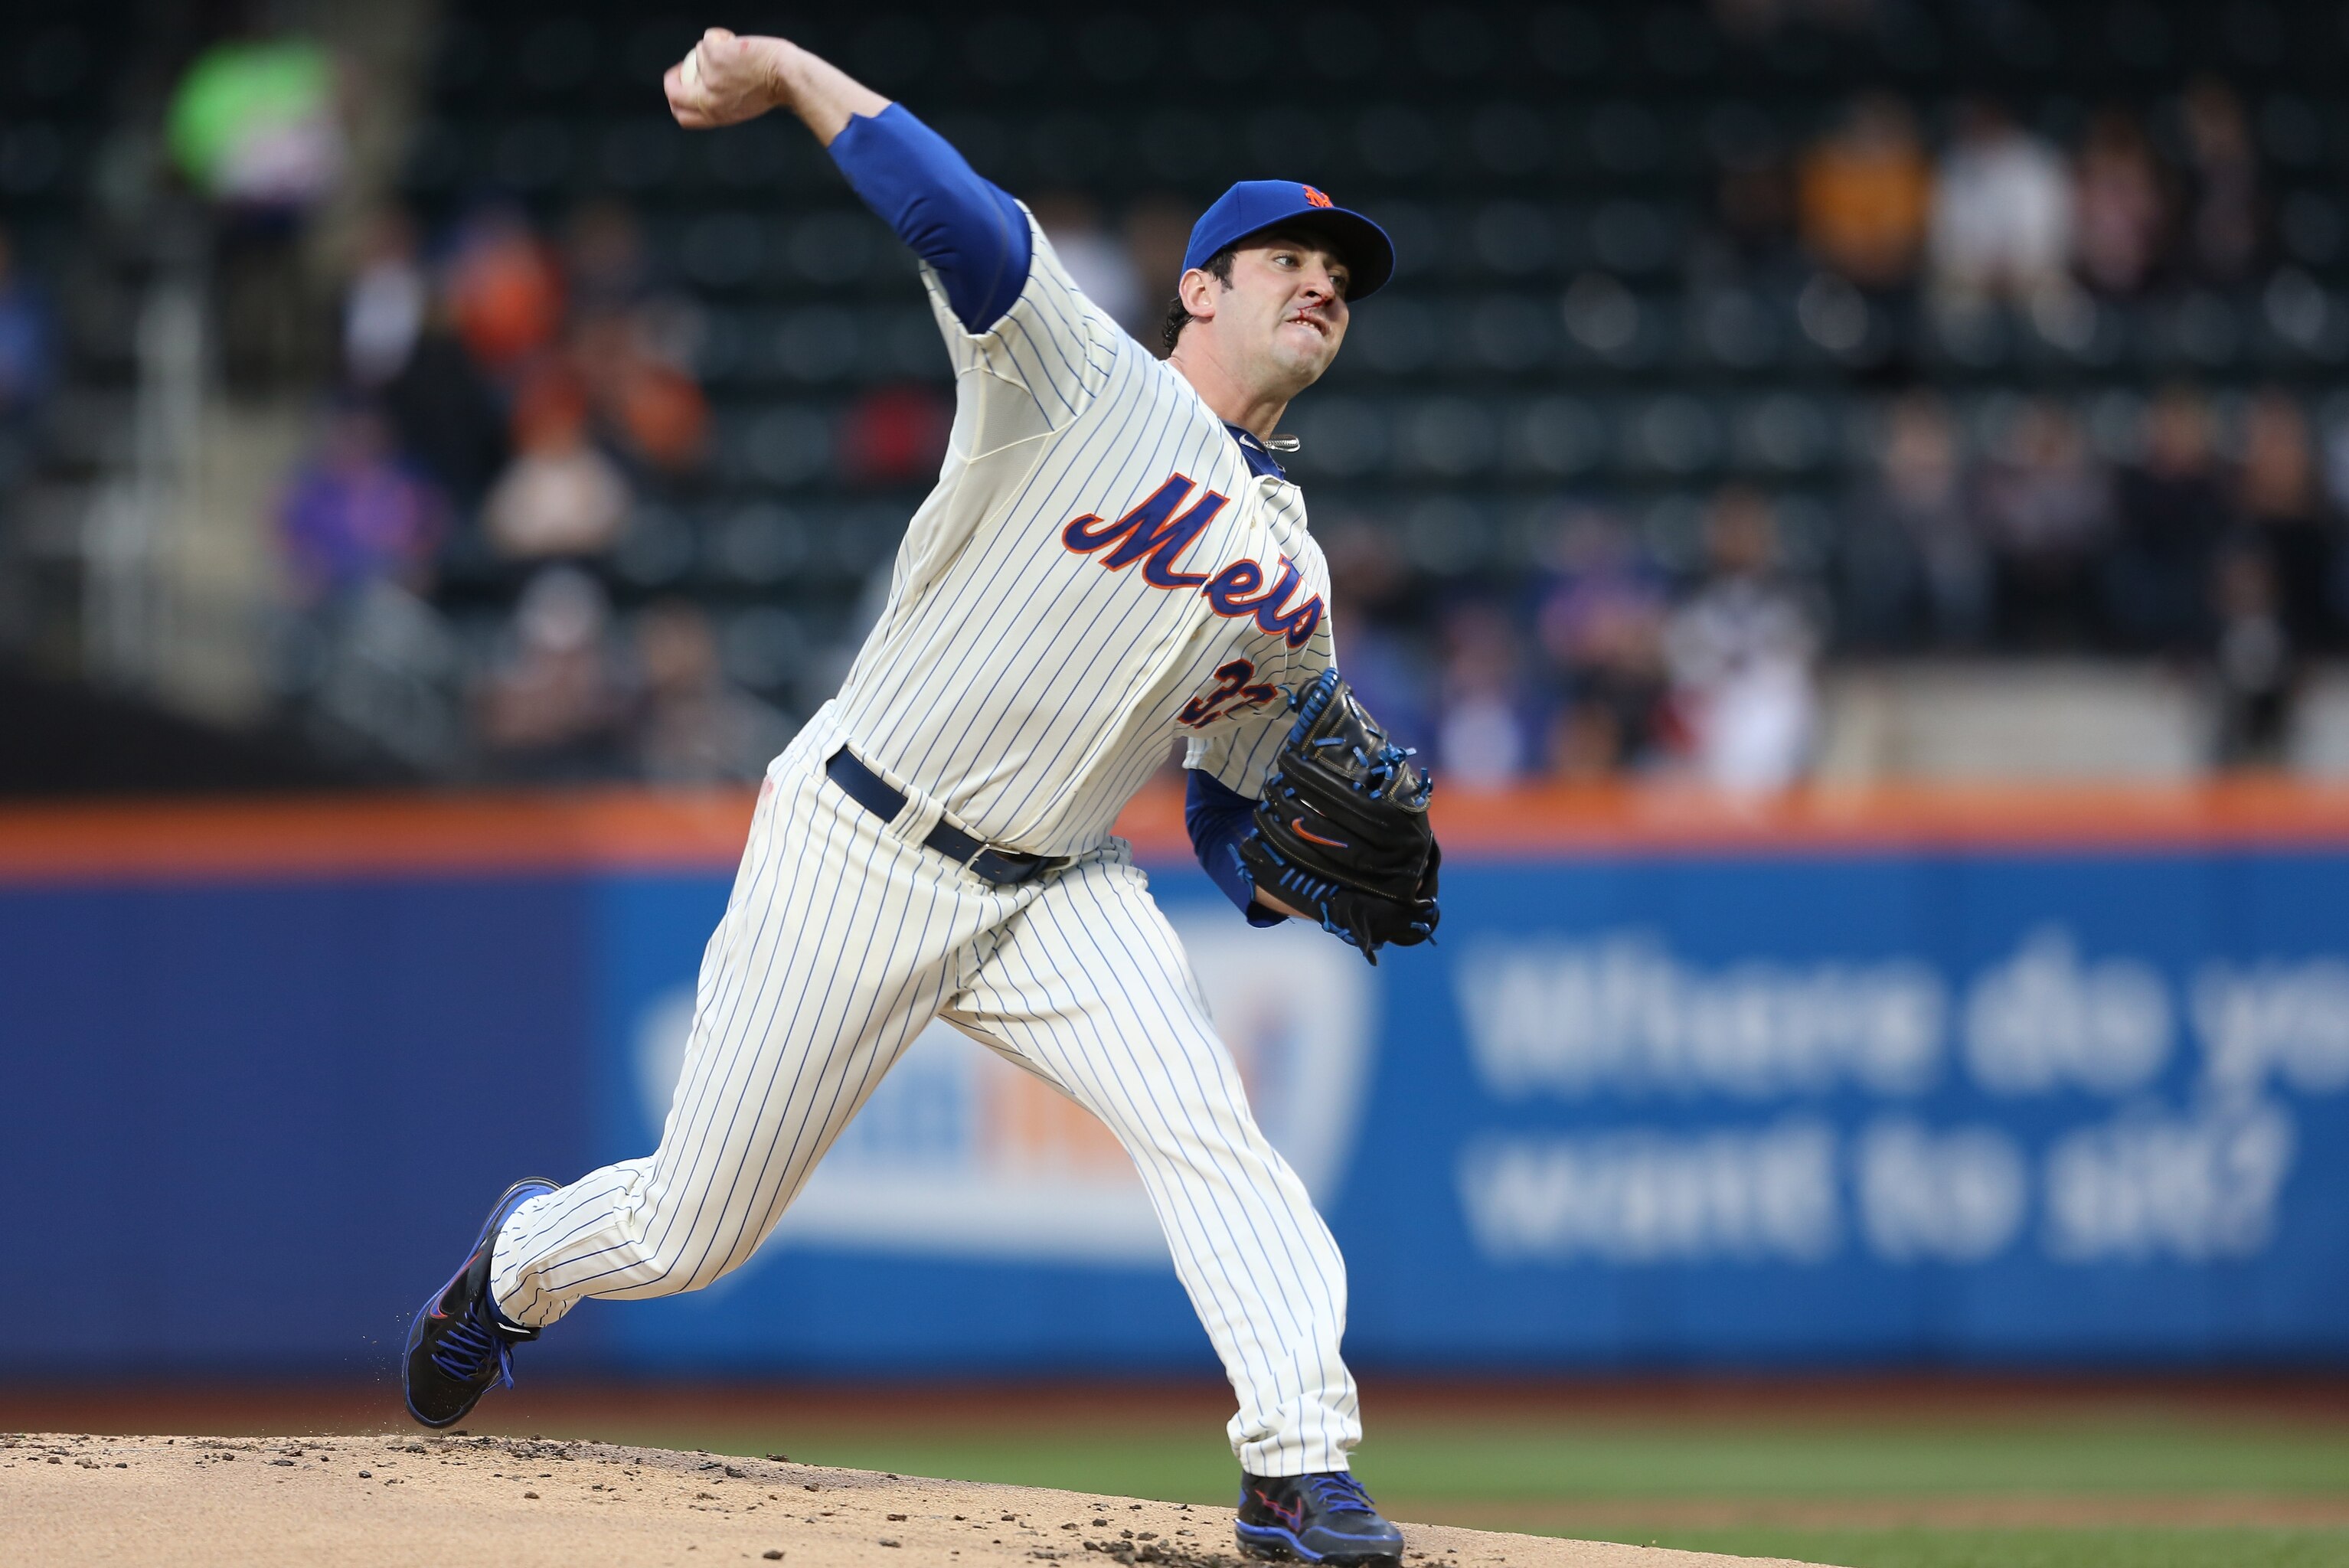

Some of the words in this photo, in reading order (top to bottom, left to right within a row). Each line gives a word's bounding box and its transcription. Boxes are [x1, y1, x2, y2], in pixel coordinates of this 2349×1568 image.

[1062, 472, 1325, 648] Mets
[1459, 934, 1949, 1095] Where
[1964, 923, 2171, 1096] do
[1459, 1124, 1836, 1265] want
[1854, 1118, 2027, 1265] to
